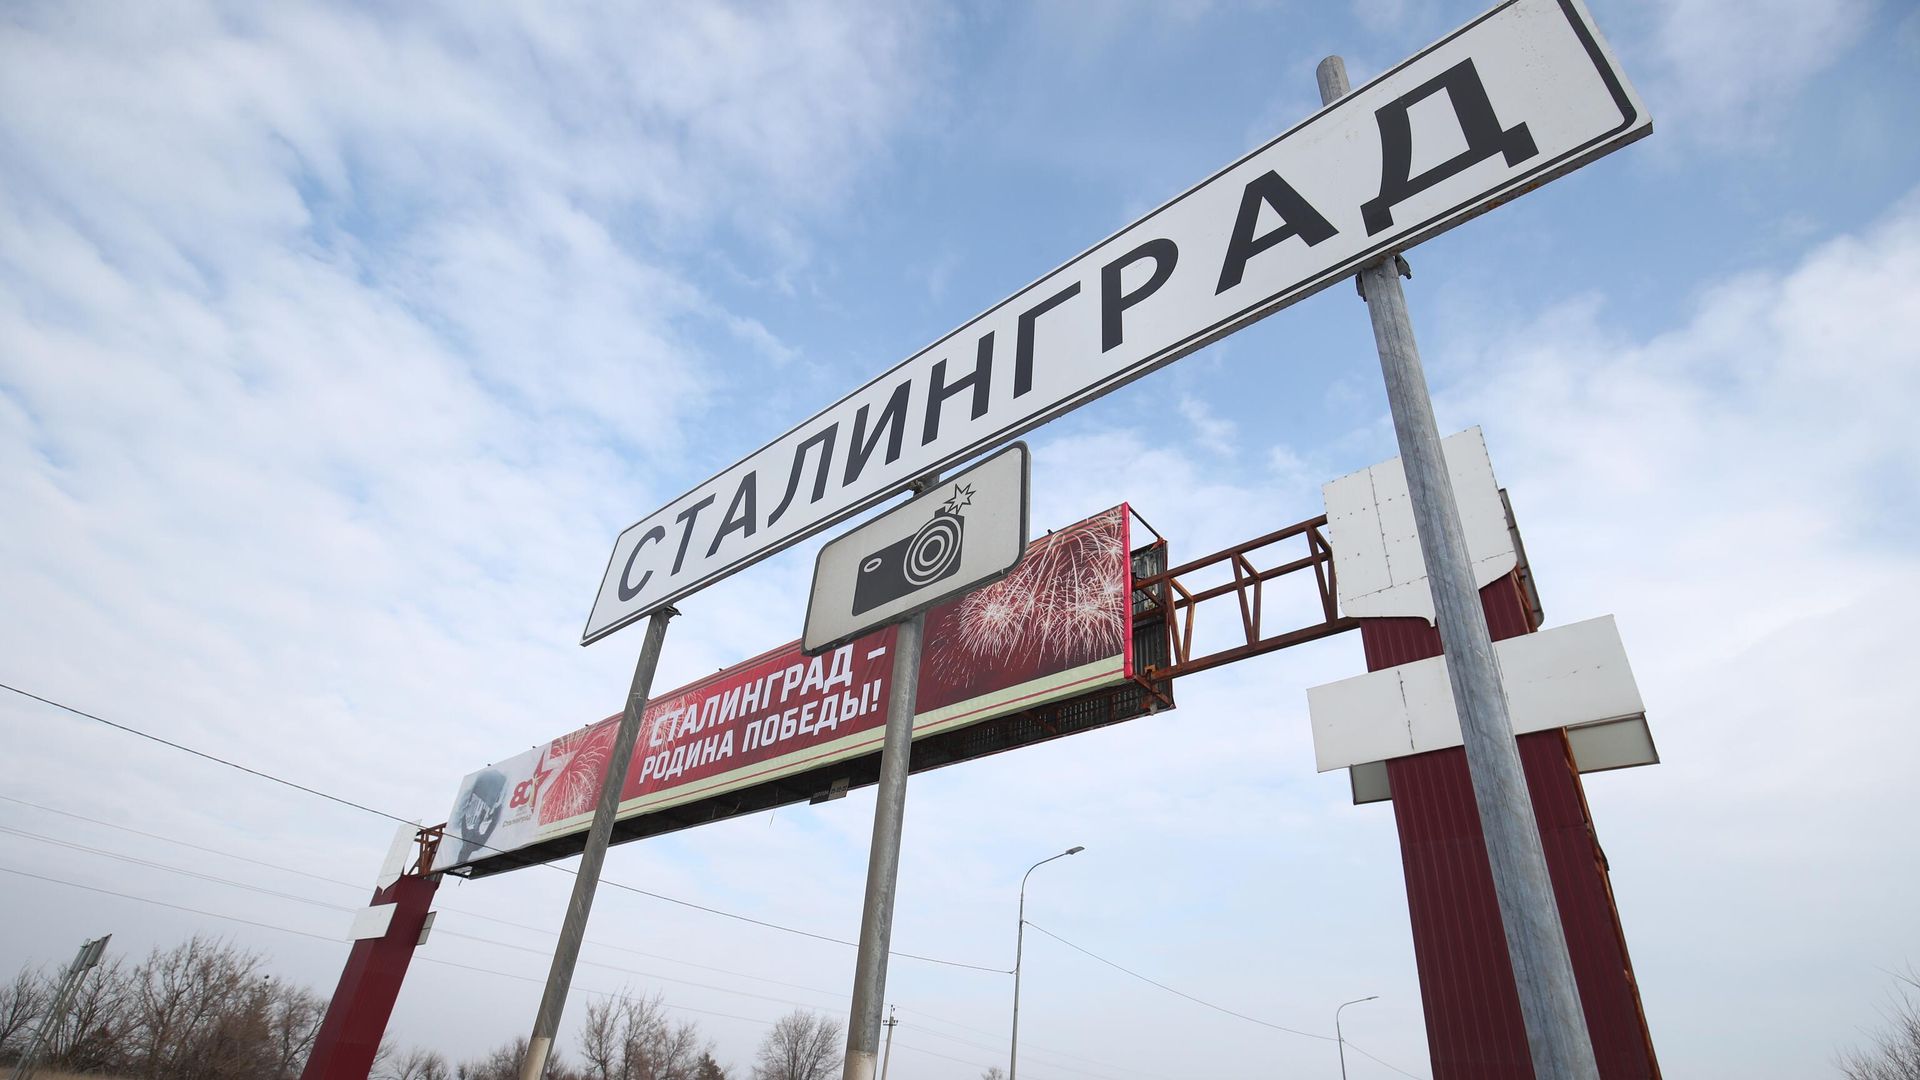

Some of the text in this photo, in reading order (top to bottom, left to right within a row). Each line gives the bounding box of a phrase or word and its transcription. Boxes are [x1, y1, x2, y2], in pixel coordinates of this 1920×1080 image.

[618, 57, 1539, 602] СТАЛИНГРАД
[639, 678, 882, 785] РОДИНА ПОБЕДЫ!
[650, 644, 854, 748] СТАЛИНГРАД
